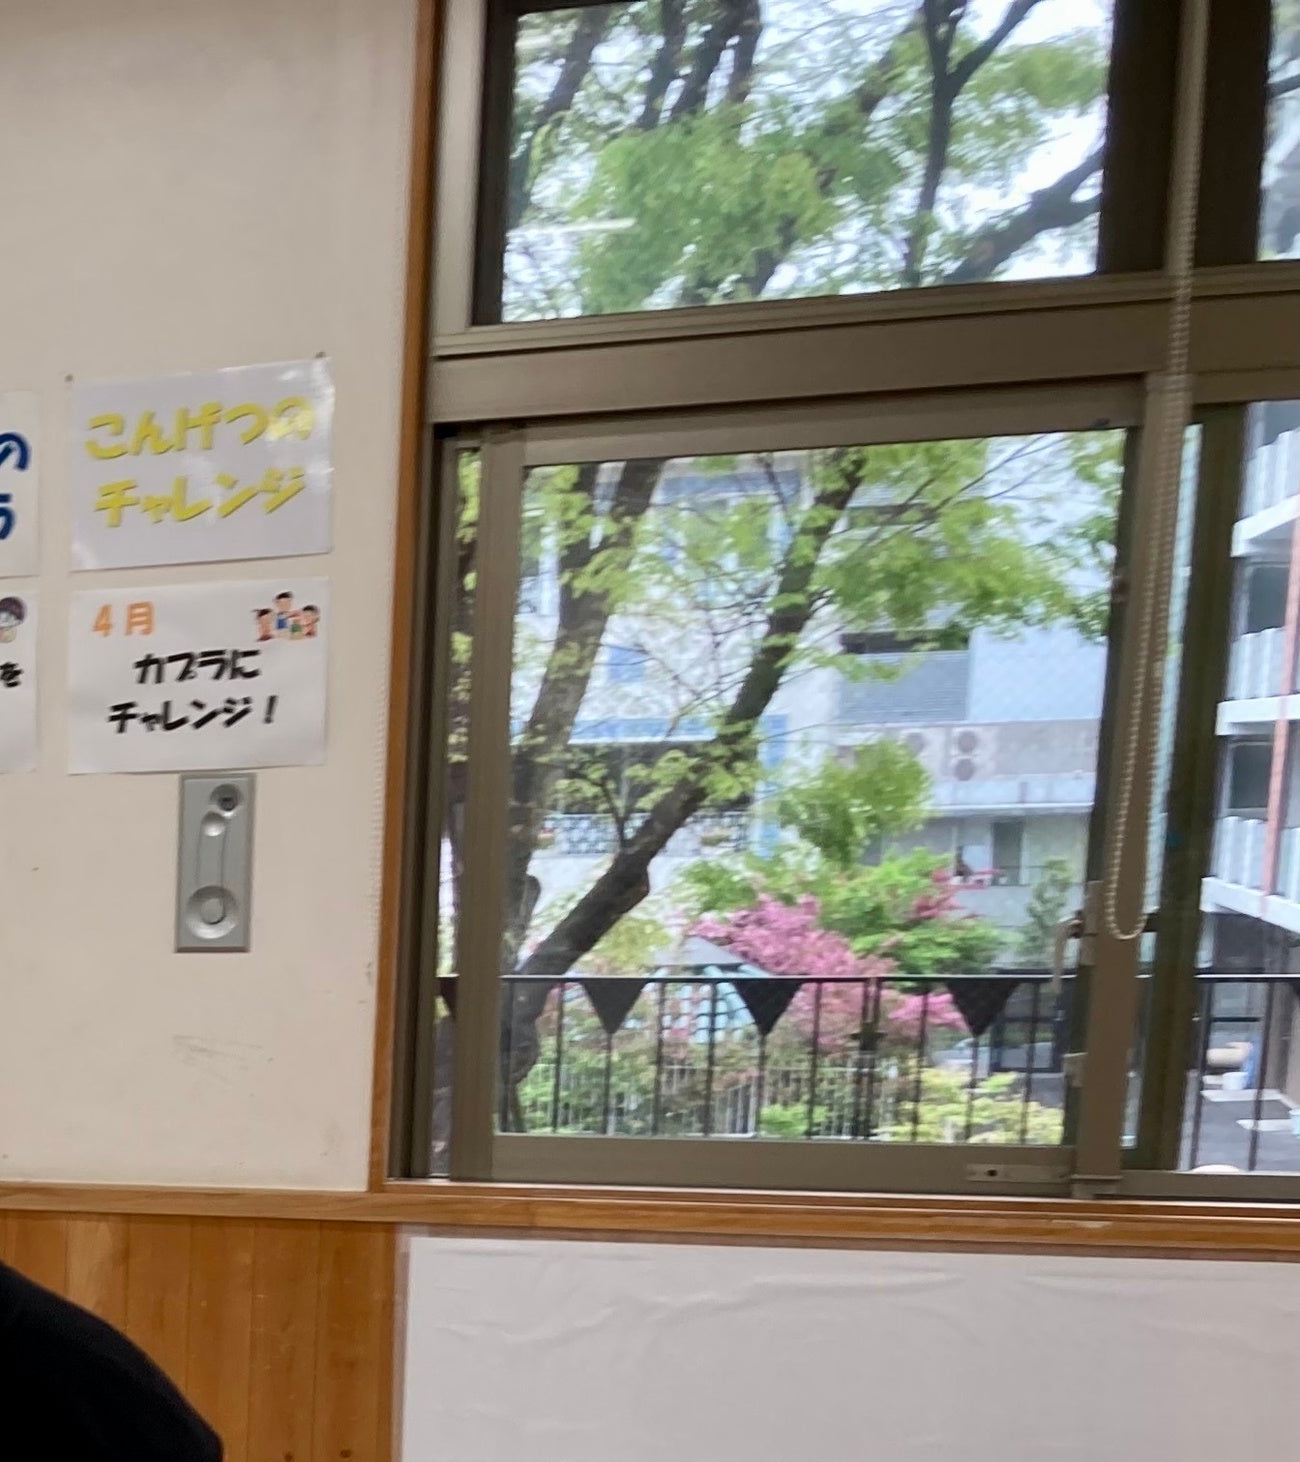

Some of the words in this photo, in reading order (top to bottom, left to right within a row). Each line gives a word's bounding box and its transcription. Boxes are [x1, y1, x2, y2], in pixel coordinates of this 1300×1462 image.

[85, 396, 314, 459] こんげつの
[94, 467, 305, 528] チャレンジ
